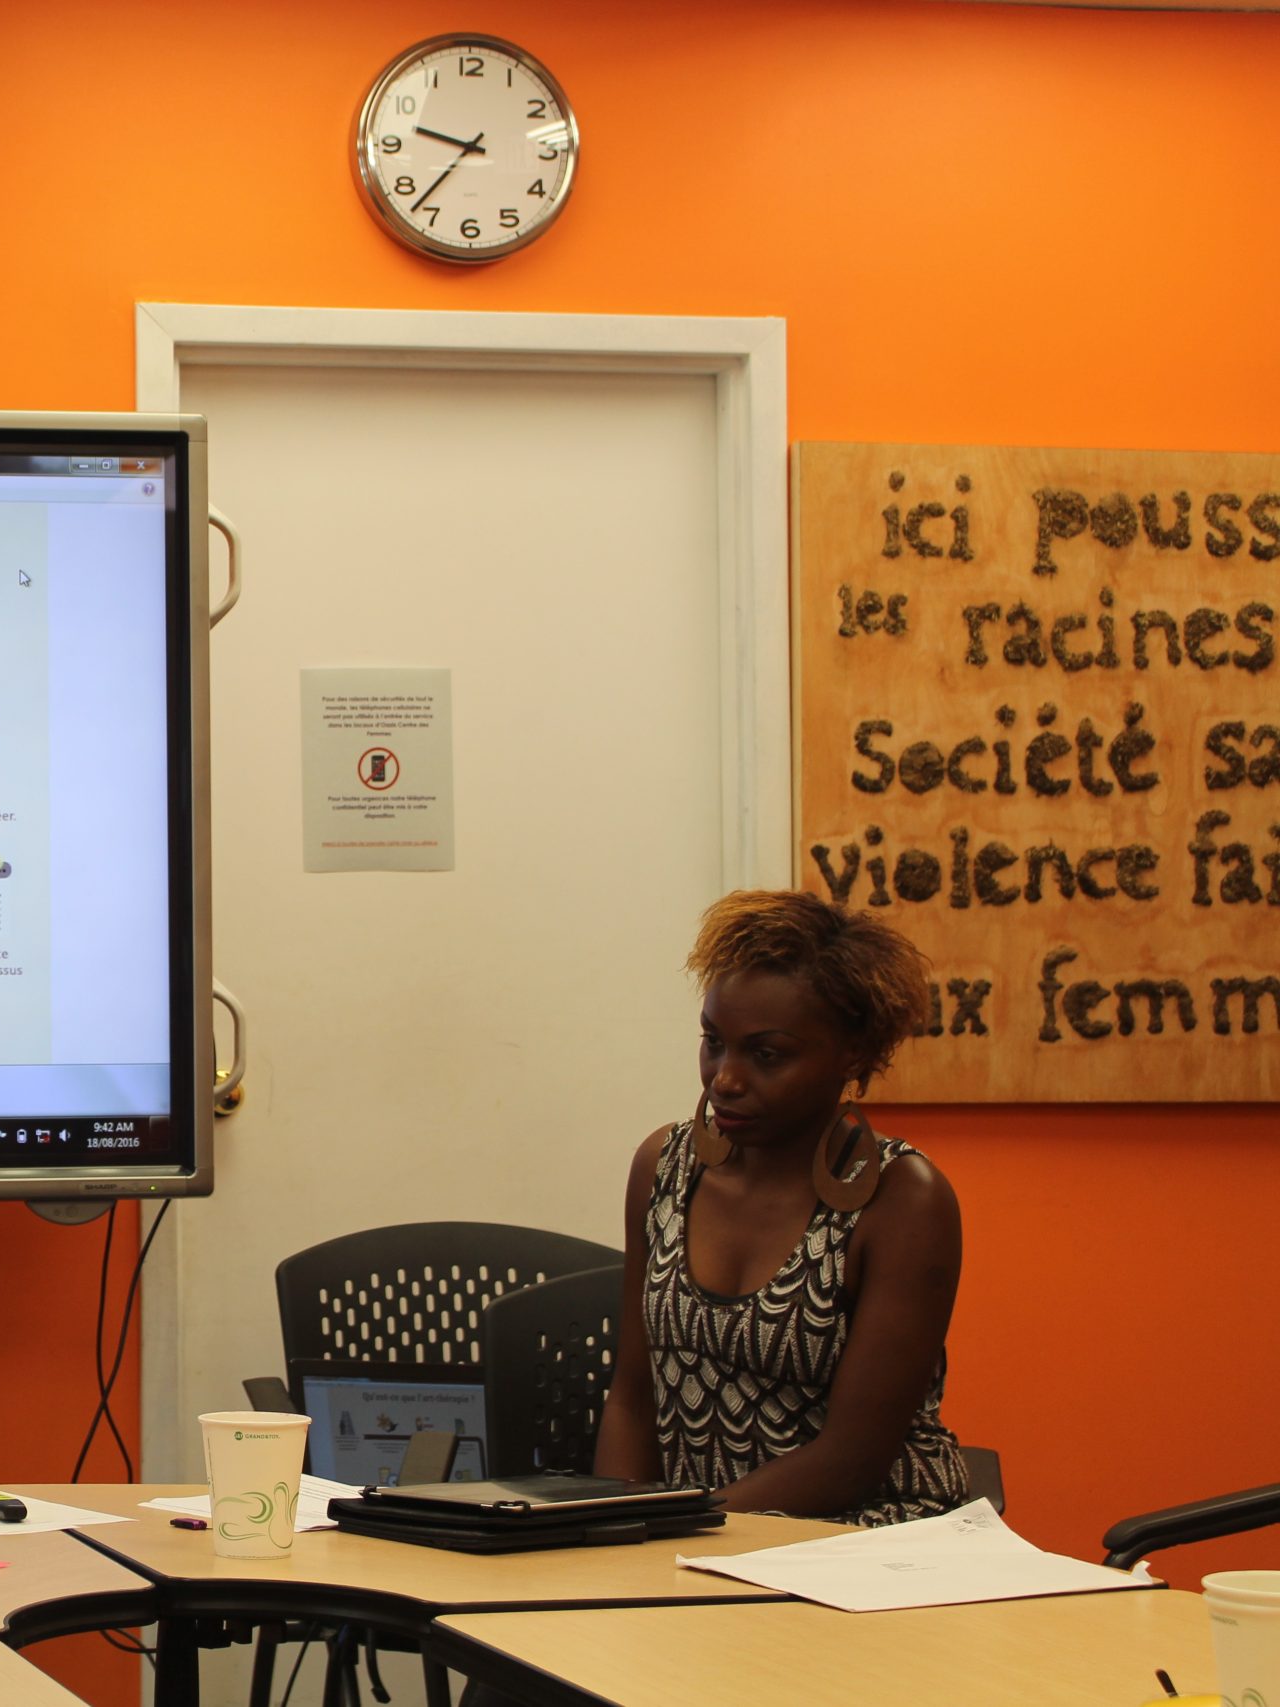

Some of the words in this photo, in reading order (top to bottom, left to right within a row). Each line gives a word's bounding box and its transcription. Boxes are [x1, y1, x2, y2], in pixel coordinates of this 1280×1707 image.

[459, 56, 484, 77] 12
[424, 70, 438, 88] 11
[507, 68, 512, 87] 1
[395, 95, 416, 115] 10
[526, 99, 546, 118] 2
[381, 135, 402, 154] 9
[394, 176, 416, 195] 8
[526, 179, 546, 198] 4
[422, 207, 440, 227] 7
[499, 208, 520, 228] 5
[460, 219, 480, 238] 6
[880, 470, 974, 562] ici
[837, 583, 909, 638] les
[962, 585, 1275, 673] racines
[851, 702, 1160, 797] Société
[810, 823, 1161, 909] violence
[93, 1121, 113, 1133] 9:42
[116, 1122, 134, 1132] AM
[86, 1137, 140, 1148] 18/08/2016
